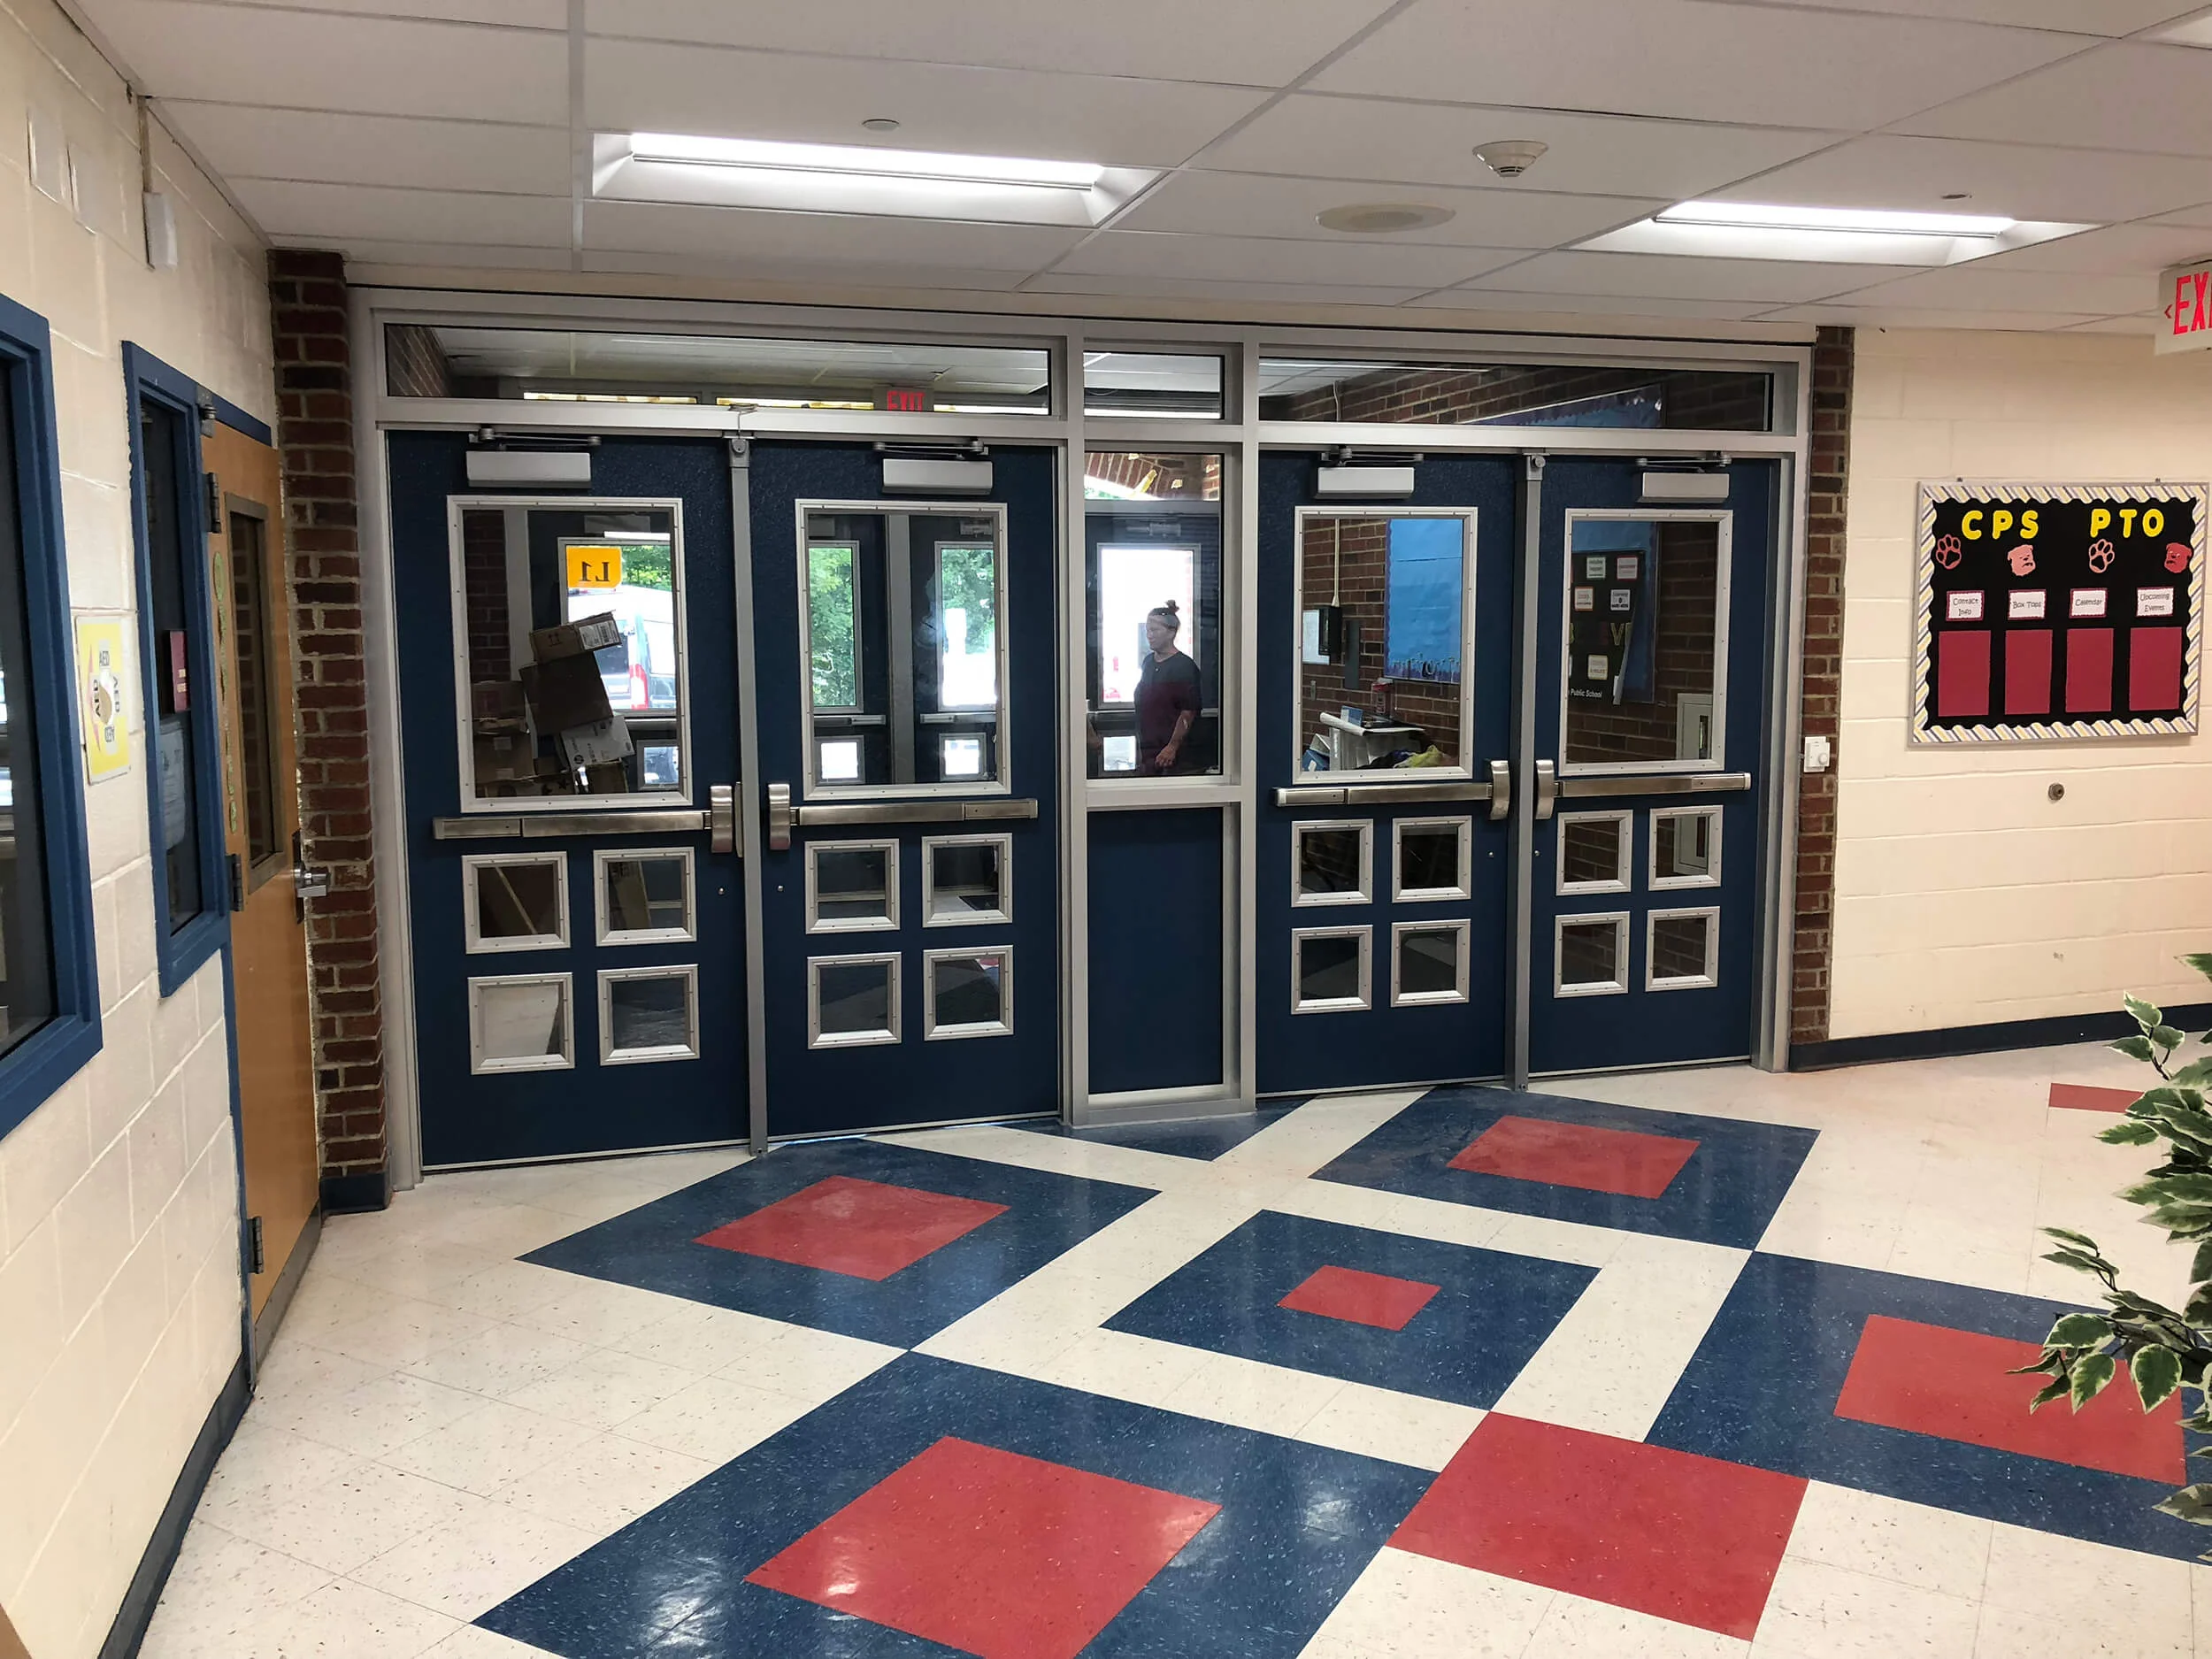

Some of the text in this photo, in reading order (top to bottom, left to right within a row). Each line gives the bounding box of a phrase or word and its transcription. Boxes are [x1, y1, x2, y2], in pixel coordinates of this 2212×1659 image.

[887, 391, 926, 411] EXIT
[1961, 508, 2164, 540] CPS PTO
[2139, 593, 2170, 602] Upcoming
[2012, 601, 2025, 610] Box
[2075, 598, 2102, 607] Calendar
[1958, 608, 1972, 617] Info
